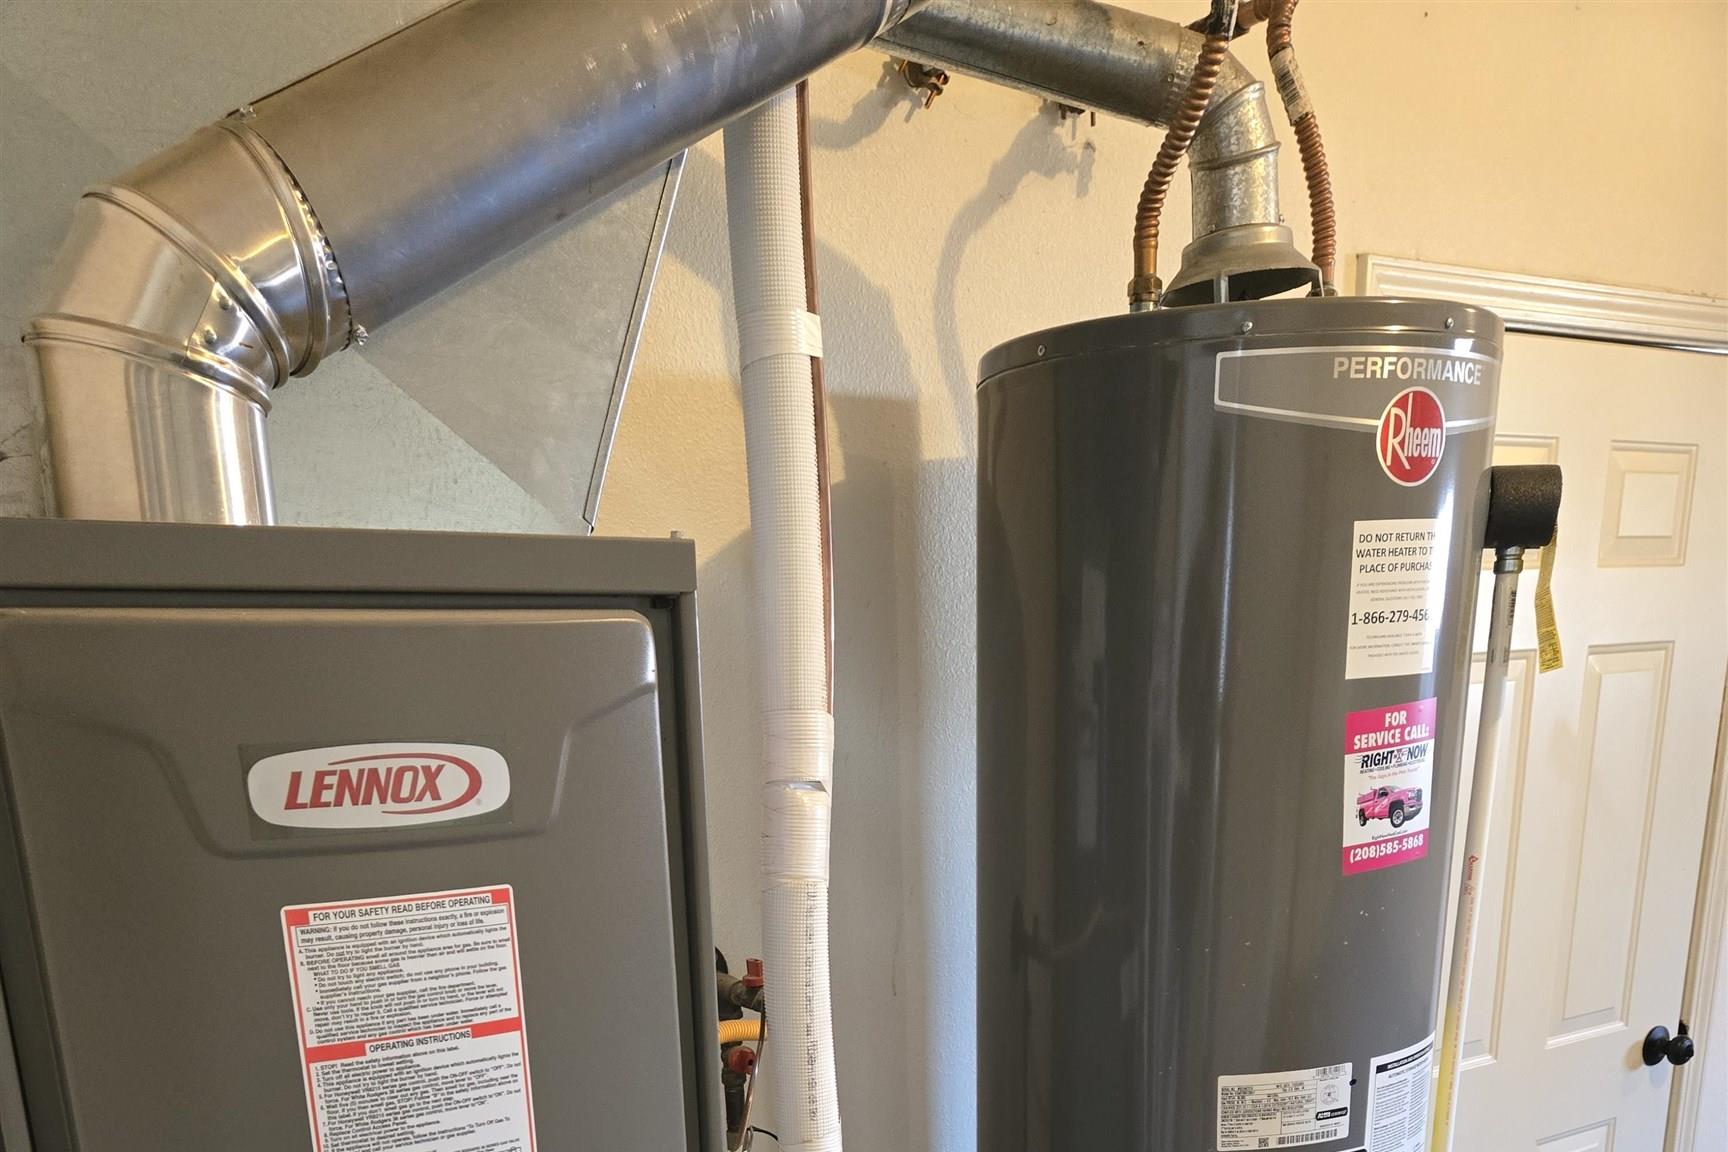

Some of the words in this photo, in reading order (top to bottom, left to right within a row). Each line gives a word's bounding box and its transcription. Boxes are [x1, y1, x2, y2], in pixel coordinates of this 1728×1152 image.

[1333, 356, 1482, 385] PERFORMANCE
[1386, 391, 1442, 470] Rheem
[1359, 533, 1373, 543] DO
[1375, 533, 1393, 543] NOT
[1395, 531, 1426, 542] RETURN
[1427, 531, 1436, 541] TH
[1356, 548, 1387, 558] WATER
[1388, 547, 1417, 557] HEATER
[1418, 546, 1428, 556] TO
[1359, 563, 1385, 573] PLACE
[1388, 562, 1398, 572] OF
[1400, 561, 1432, 572] PURCHAS
[1351, 608, 1430, 625] 1-866-279-456
[1385, 710, 1407, 728] FOR
[1354, 729, 1400, 750] SERVICE
[1404, 725, 1430, 743] CALL:
[1361, 750, 1395, 768] RIGHT
[1407, 745, 1428, 761] NOW
[284, 764, 446, 810] LENNOX
[1349, 833, 1423, 864] (208)585-5868
[313, 912, 330, 921] FOR
[333, 910, 356, 919] YOUR
[358, 906, 389, 917] SAFETY
[391, 904, 413, 913] READ
[415, 900, 446, 911] BEFORE
[447, 895, 490, 908] OPERATING
[368, 1038, 414, 1053] OPERATING
[415, 1029, 470, 1046] INSTRUCTIONS
